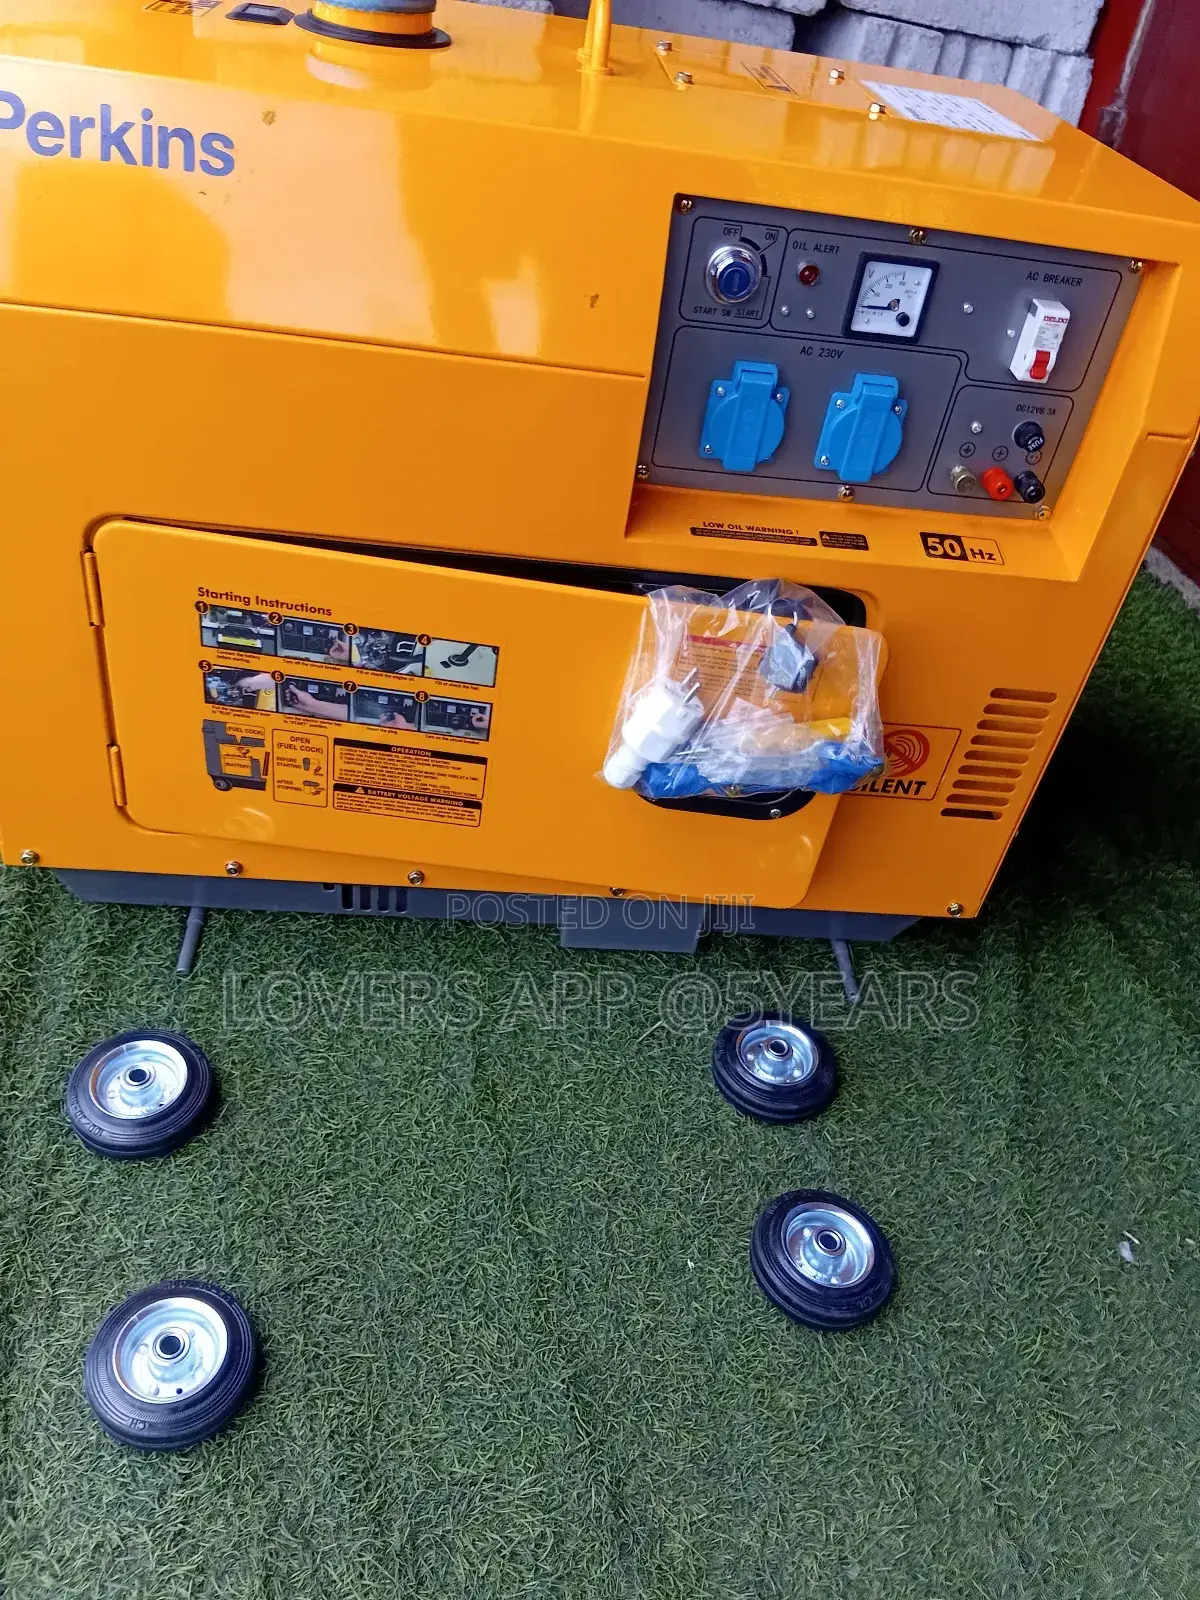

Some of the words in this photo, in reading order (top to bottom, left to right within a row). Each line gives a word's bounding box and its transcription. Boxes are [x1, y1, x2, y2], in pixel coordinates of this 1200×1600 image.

[723, 227, 740, 237] OFF
[765, 231, 777, 241] ON
[792, 240, 808, 251] OIL
[813, 243, 841, 255] ALERT
[1026, 271, 1039, 281] AC
[1043, 273, 1083, 288] BREAKER
[693, 306, 717, 316] START
[721, 308, 731, 316] SW
[736, 307, 759, 317] START
[799, 346, 813, 357] AC
[818, 347, 844, 359] 230V
[1028, 437, 1044, 451] FUSE
[703, 521, 724, 529] LOW
[727, 523, 744, 531] OIL
[745, 525, 793, 535] WARNING
[927, 538, 963, 558] 50
[970, 548, 997, 562] Hz
[197, 587, 251, 606] Starting
[256, 595, 332, 616] Instructions
[200, 604, 204, 612] 1
[272, 614, 278, 623] 2
[348, 625, 353, 634] 3
[421, 636, 427, 645] 4
[202, 662, 208, 671] 5
[274, 671, 280, 680] 6
[348, 682, 353, 690] 7
[290, 736, 311, 745] OPEN
[277, 743, 298, 751] (FUEL
[300, 745, 324, 755] COCK)
[391, 747, 431, 757] OPERATION
[367, 789, 396, 798] BATTERY
[398, 792, 429, 802] VOLTAGE
[430, 797, 464, 806] WARNING
